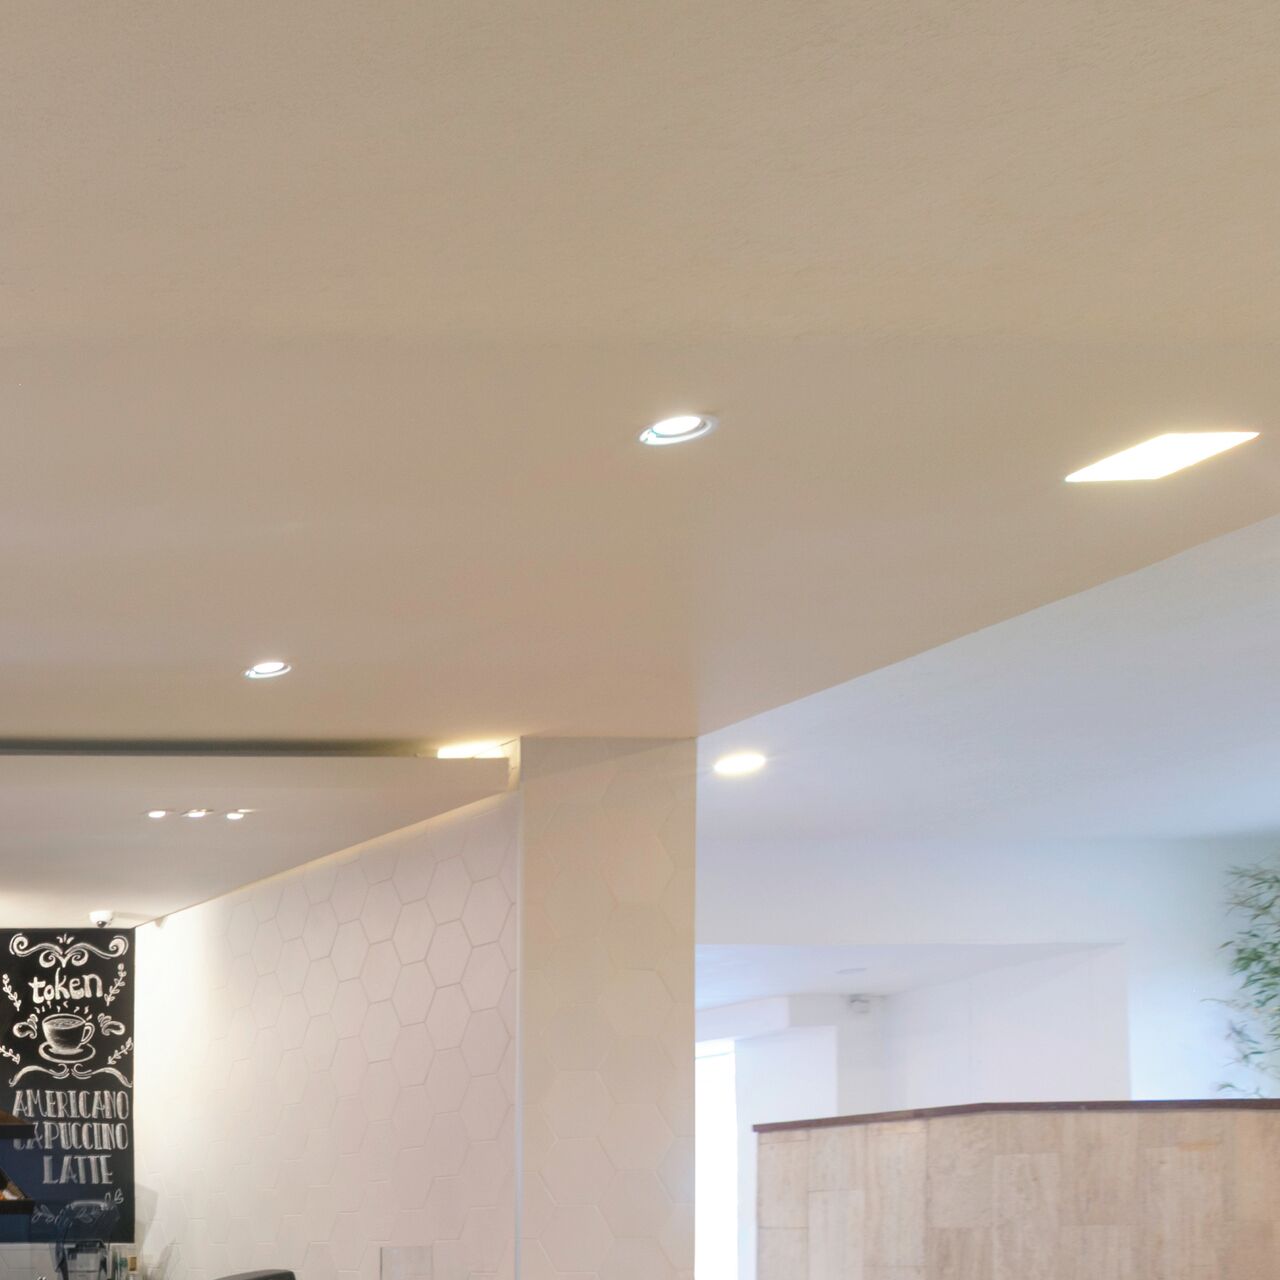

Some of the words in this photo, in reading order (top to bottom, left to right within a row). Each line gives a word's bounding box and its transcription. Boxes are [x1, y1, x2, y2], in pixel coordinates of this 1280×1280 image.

[28, 967, 103, 1004] token
[12, 1089, 129, 1119] AMERICANO
[42, 1154, 113, 1184] LATTE
